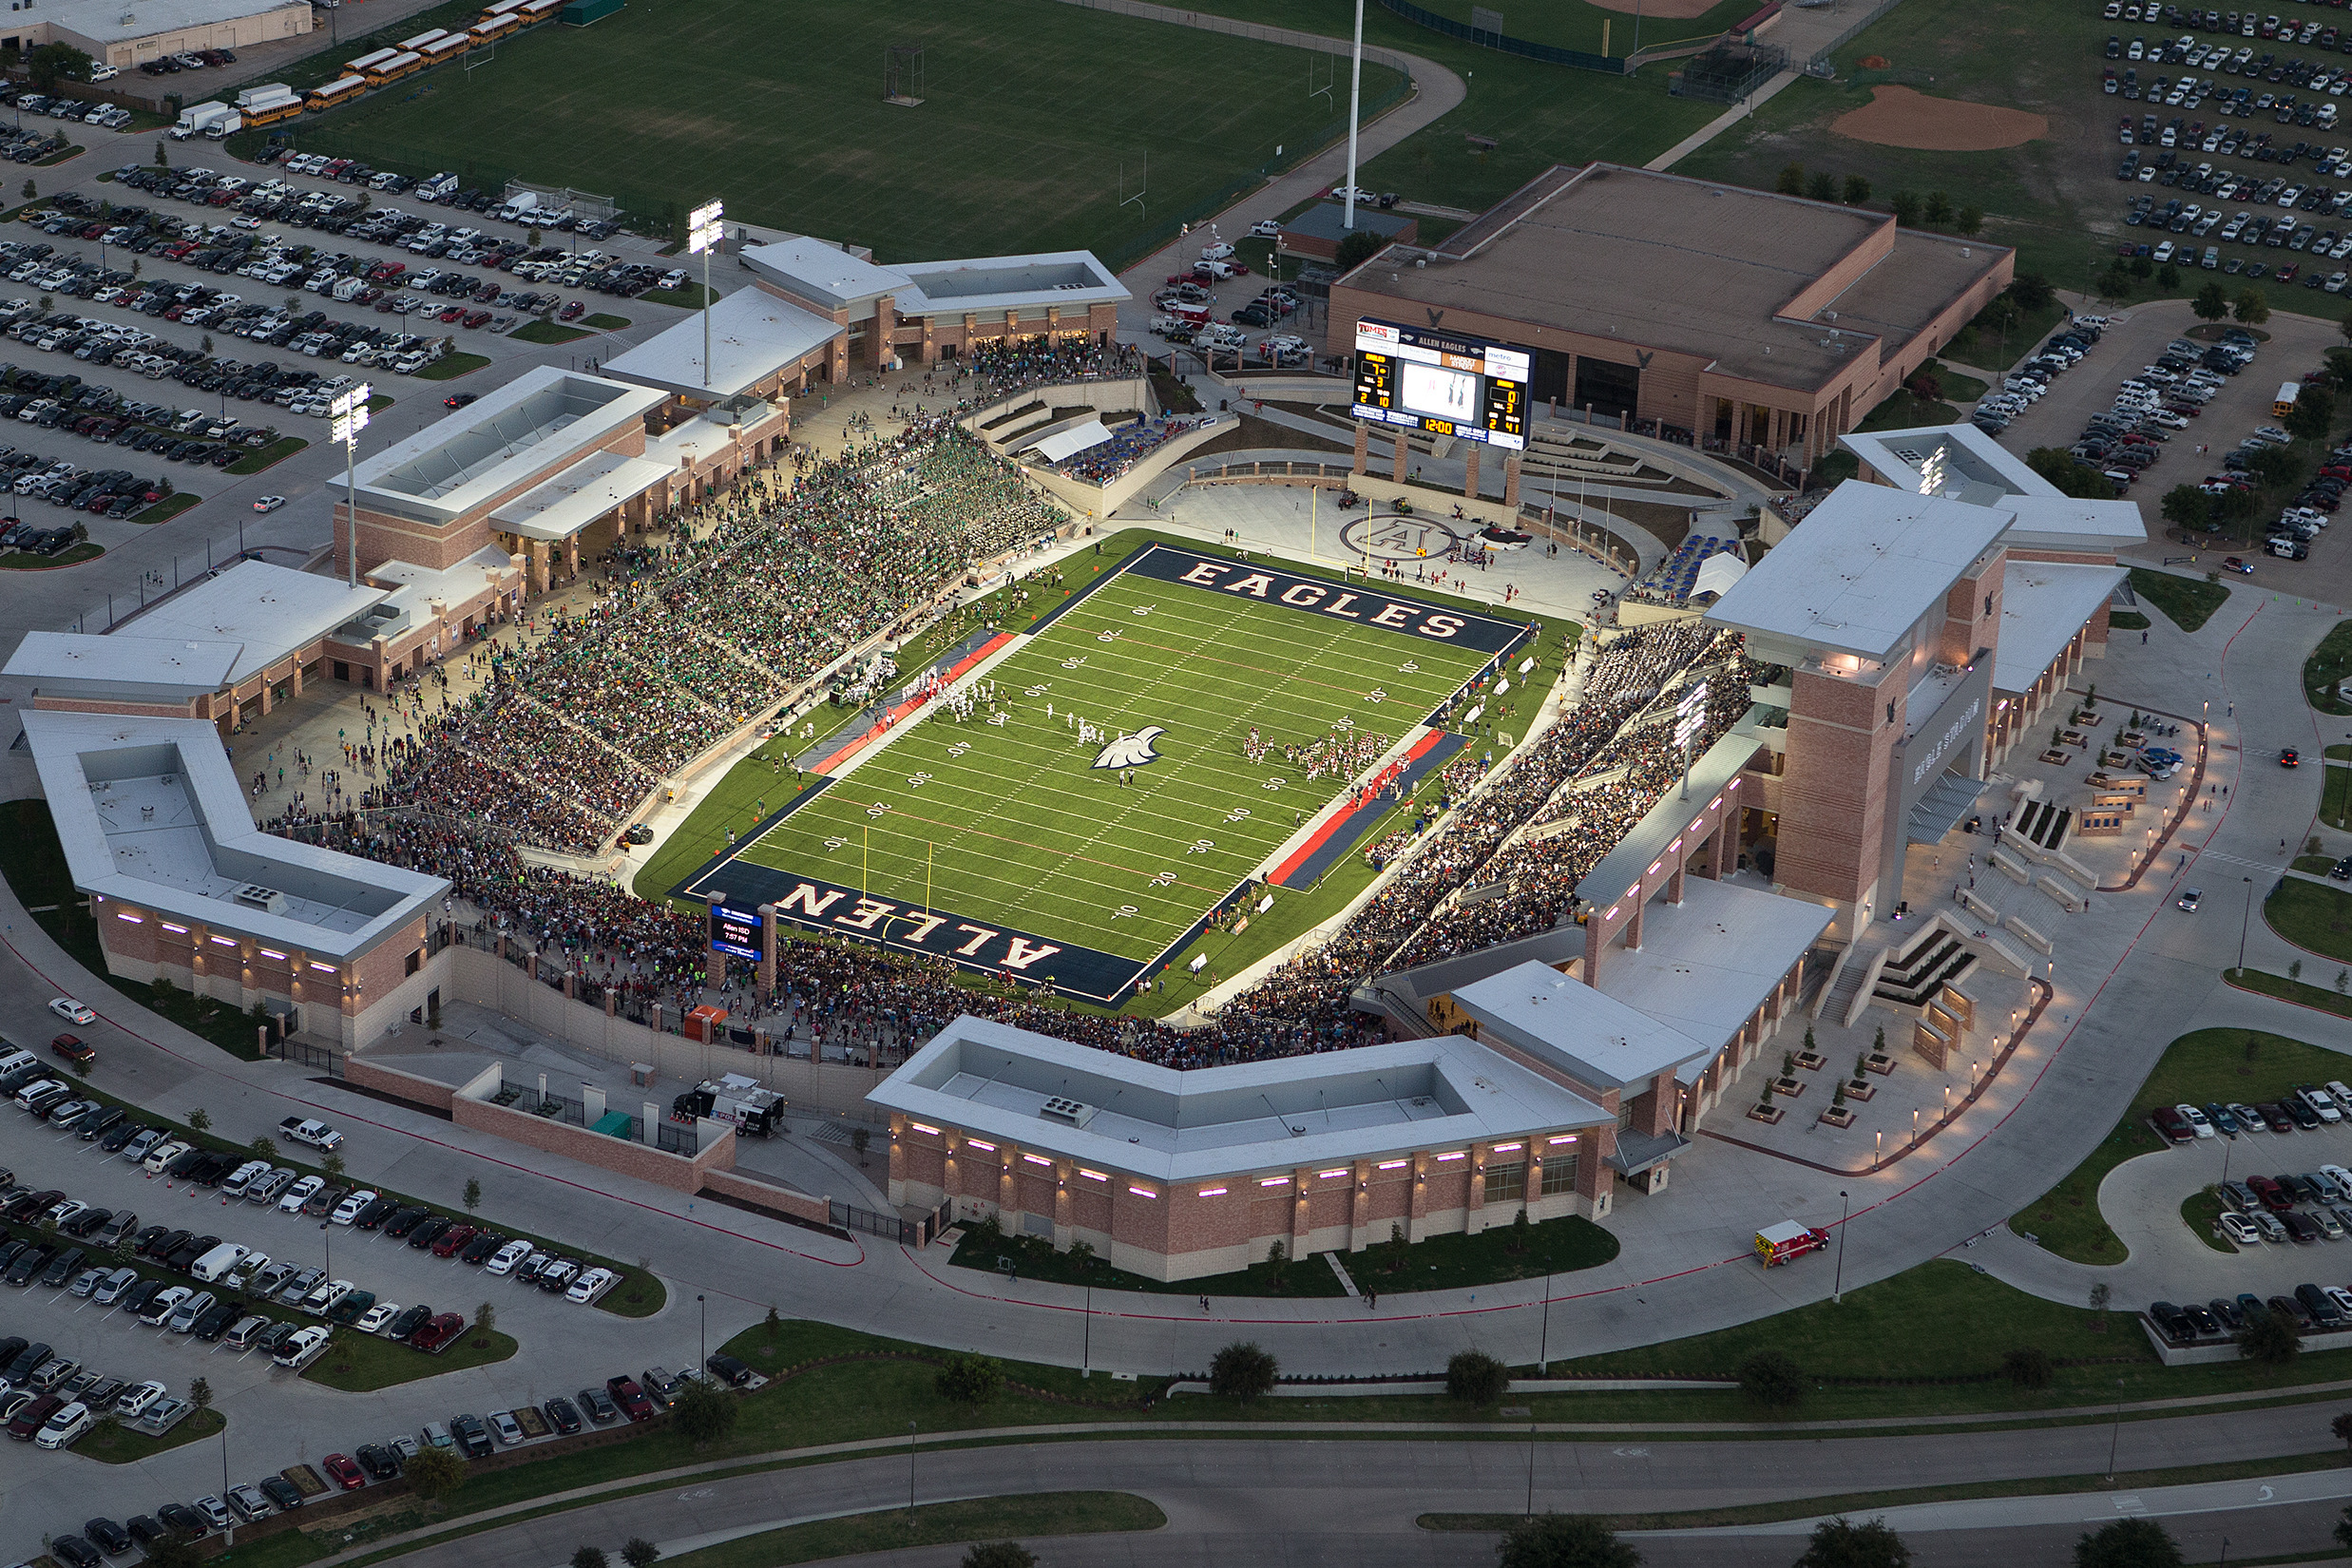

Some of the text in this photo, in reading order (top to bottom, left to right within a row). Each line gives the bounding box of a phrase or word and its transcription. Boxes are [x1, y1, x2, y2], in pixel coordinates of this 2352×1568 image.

[1358, 323, 1387, 338] TOMES
[1419, 336, 1466, 354] ALLEN EAGLES
[1449, 354, 1477, 367] MARKET
[1488, 351, 1511, 361] metro
[1372, 363, 1379, 374] 7
[1376, 377, 1384, 388] 3
[1360, 392, 1389, 408] 2 10
[1508, 391, 1516, 403] 0
[1506, 403, 1514, 414] 3
[1425, 419, 1453, 435] 12:00
[1489, 419, 1519, 433] 2 41
[1353, 519, 1435, 555] A
[1416, 547, 1426, 557] 25
[1179, 562, 1467, 639] EAGLES
[1914, 698, 1979, 784] EAGLE STADIUM
[1262, 776, 1287, 791] 50
[723, 923, 750, 935] Allen ISD
[773, 883, 1061, 969] ALLEN
[737, 935, 748, 944] PM
